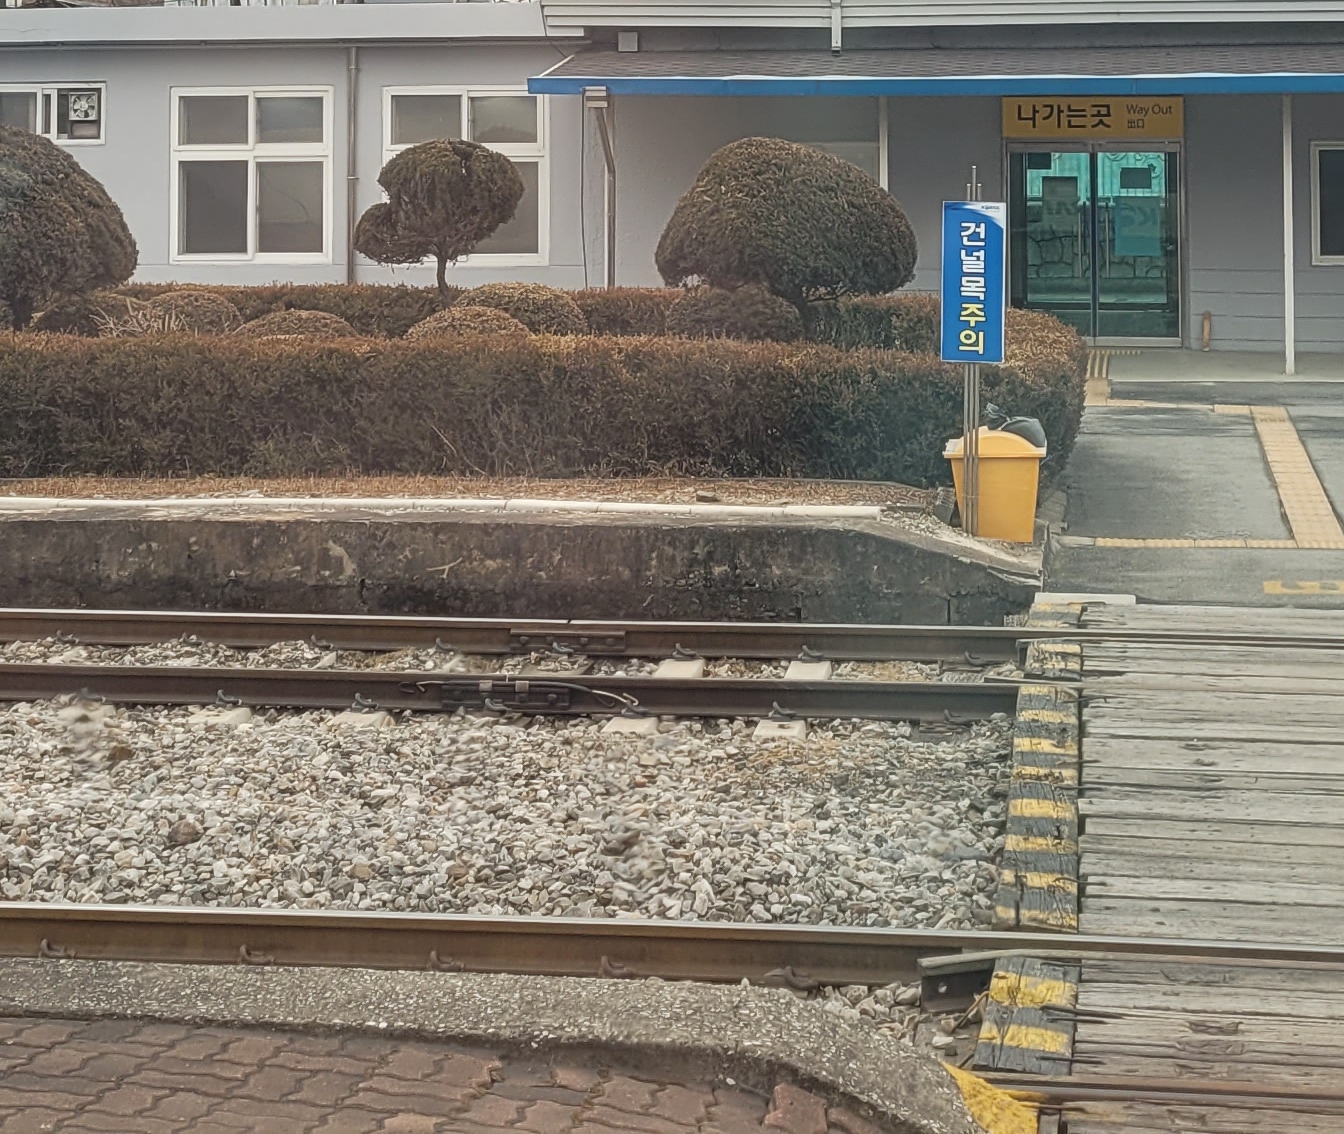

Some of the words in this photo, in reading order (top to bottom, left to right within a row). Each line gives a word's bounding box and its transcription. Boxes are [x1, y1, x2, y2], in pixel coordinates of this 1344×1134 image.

[1016, 103, 1112, 130] 나가는곳
[1126, 104, 1150, 117] Way
[1151, 104, 1173, 115] Out
[1127, 118, 1145, 130] 出口
